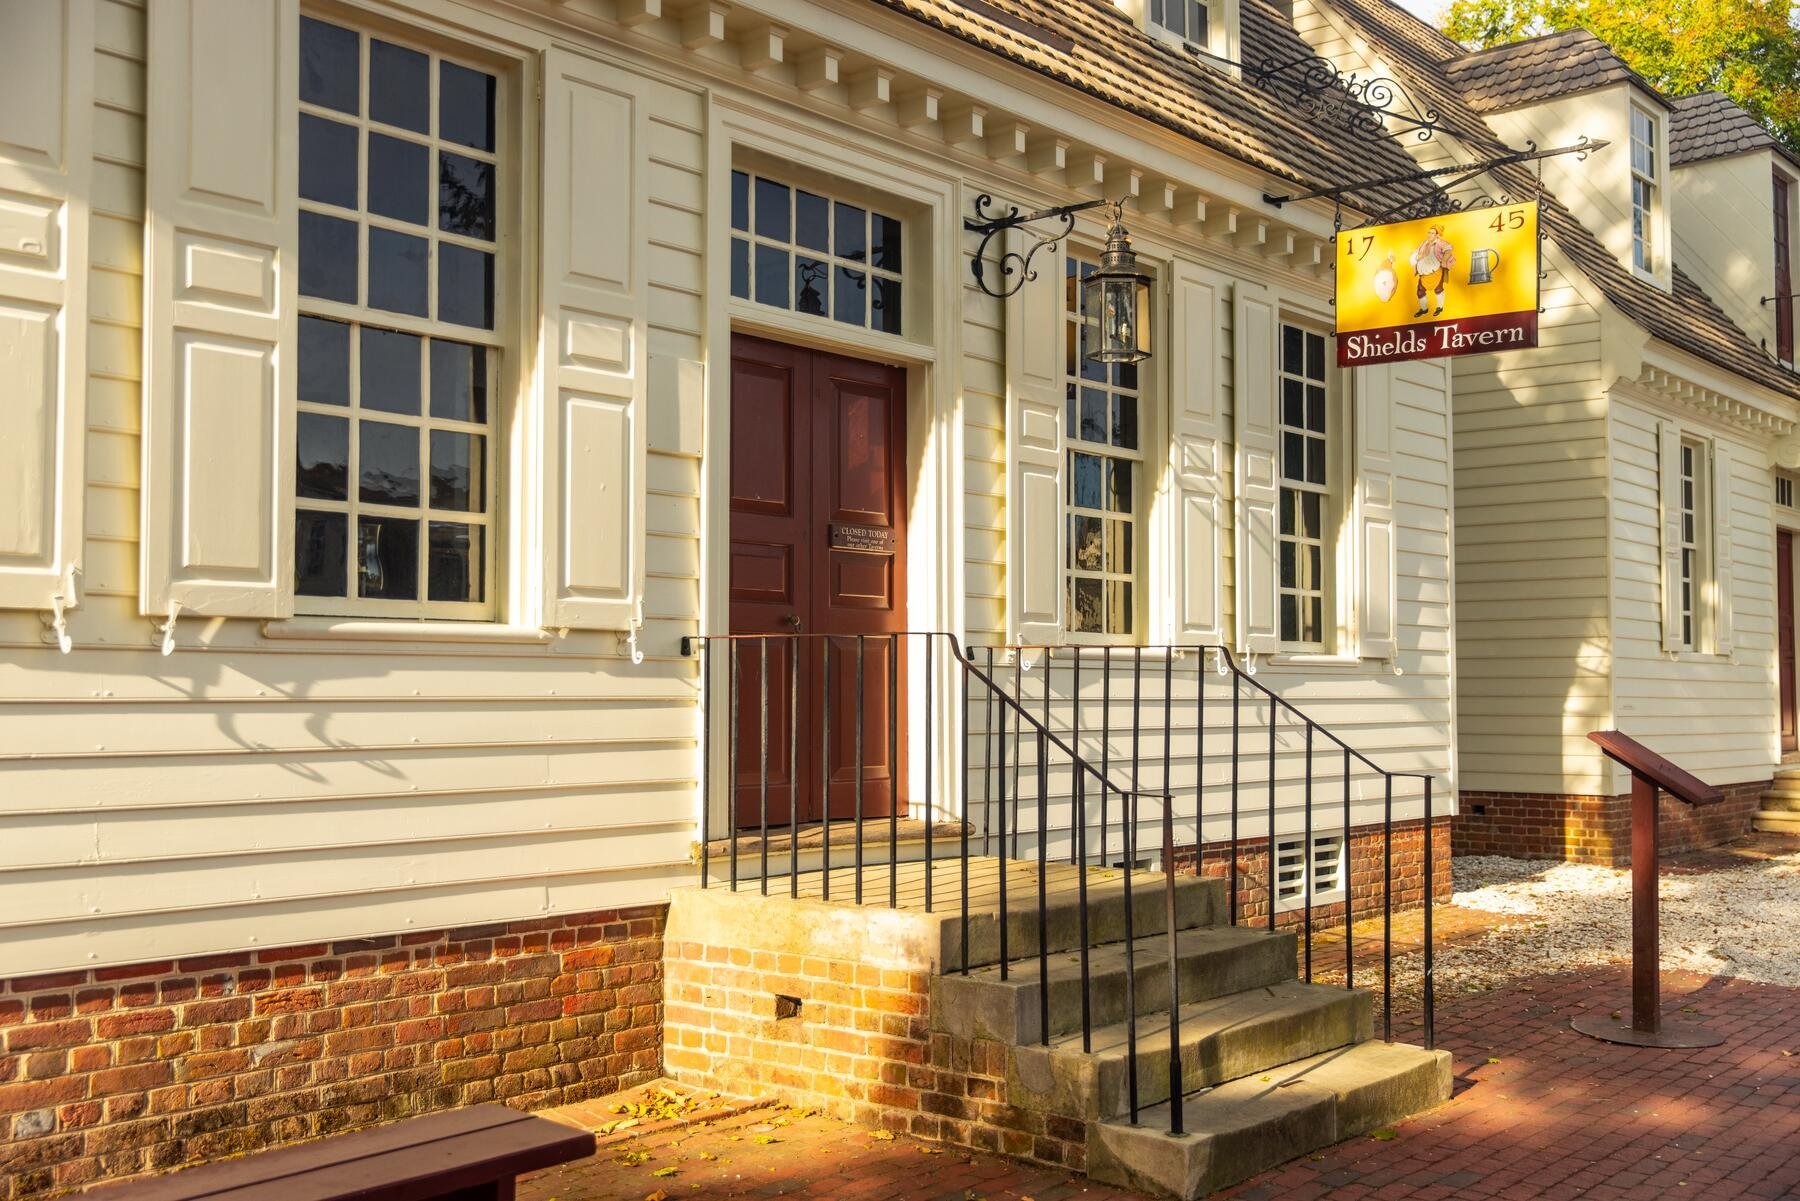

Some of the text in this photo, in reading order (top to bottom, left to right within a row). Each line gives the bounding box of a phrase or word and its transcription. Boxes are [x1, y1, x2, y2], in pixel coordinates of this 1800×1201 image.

[1488, 210, 1525, 232] 45
[1346, 235, 1375, 261] 17
[1347, 323, 1523, 359] Shields Tavern
[841, 527, 889, 539] CLOSED TODAY
